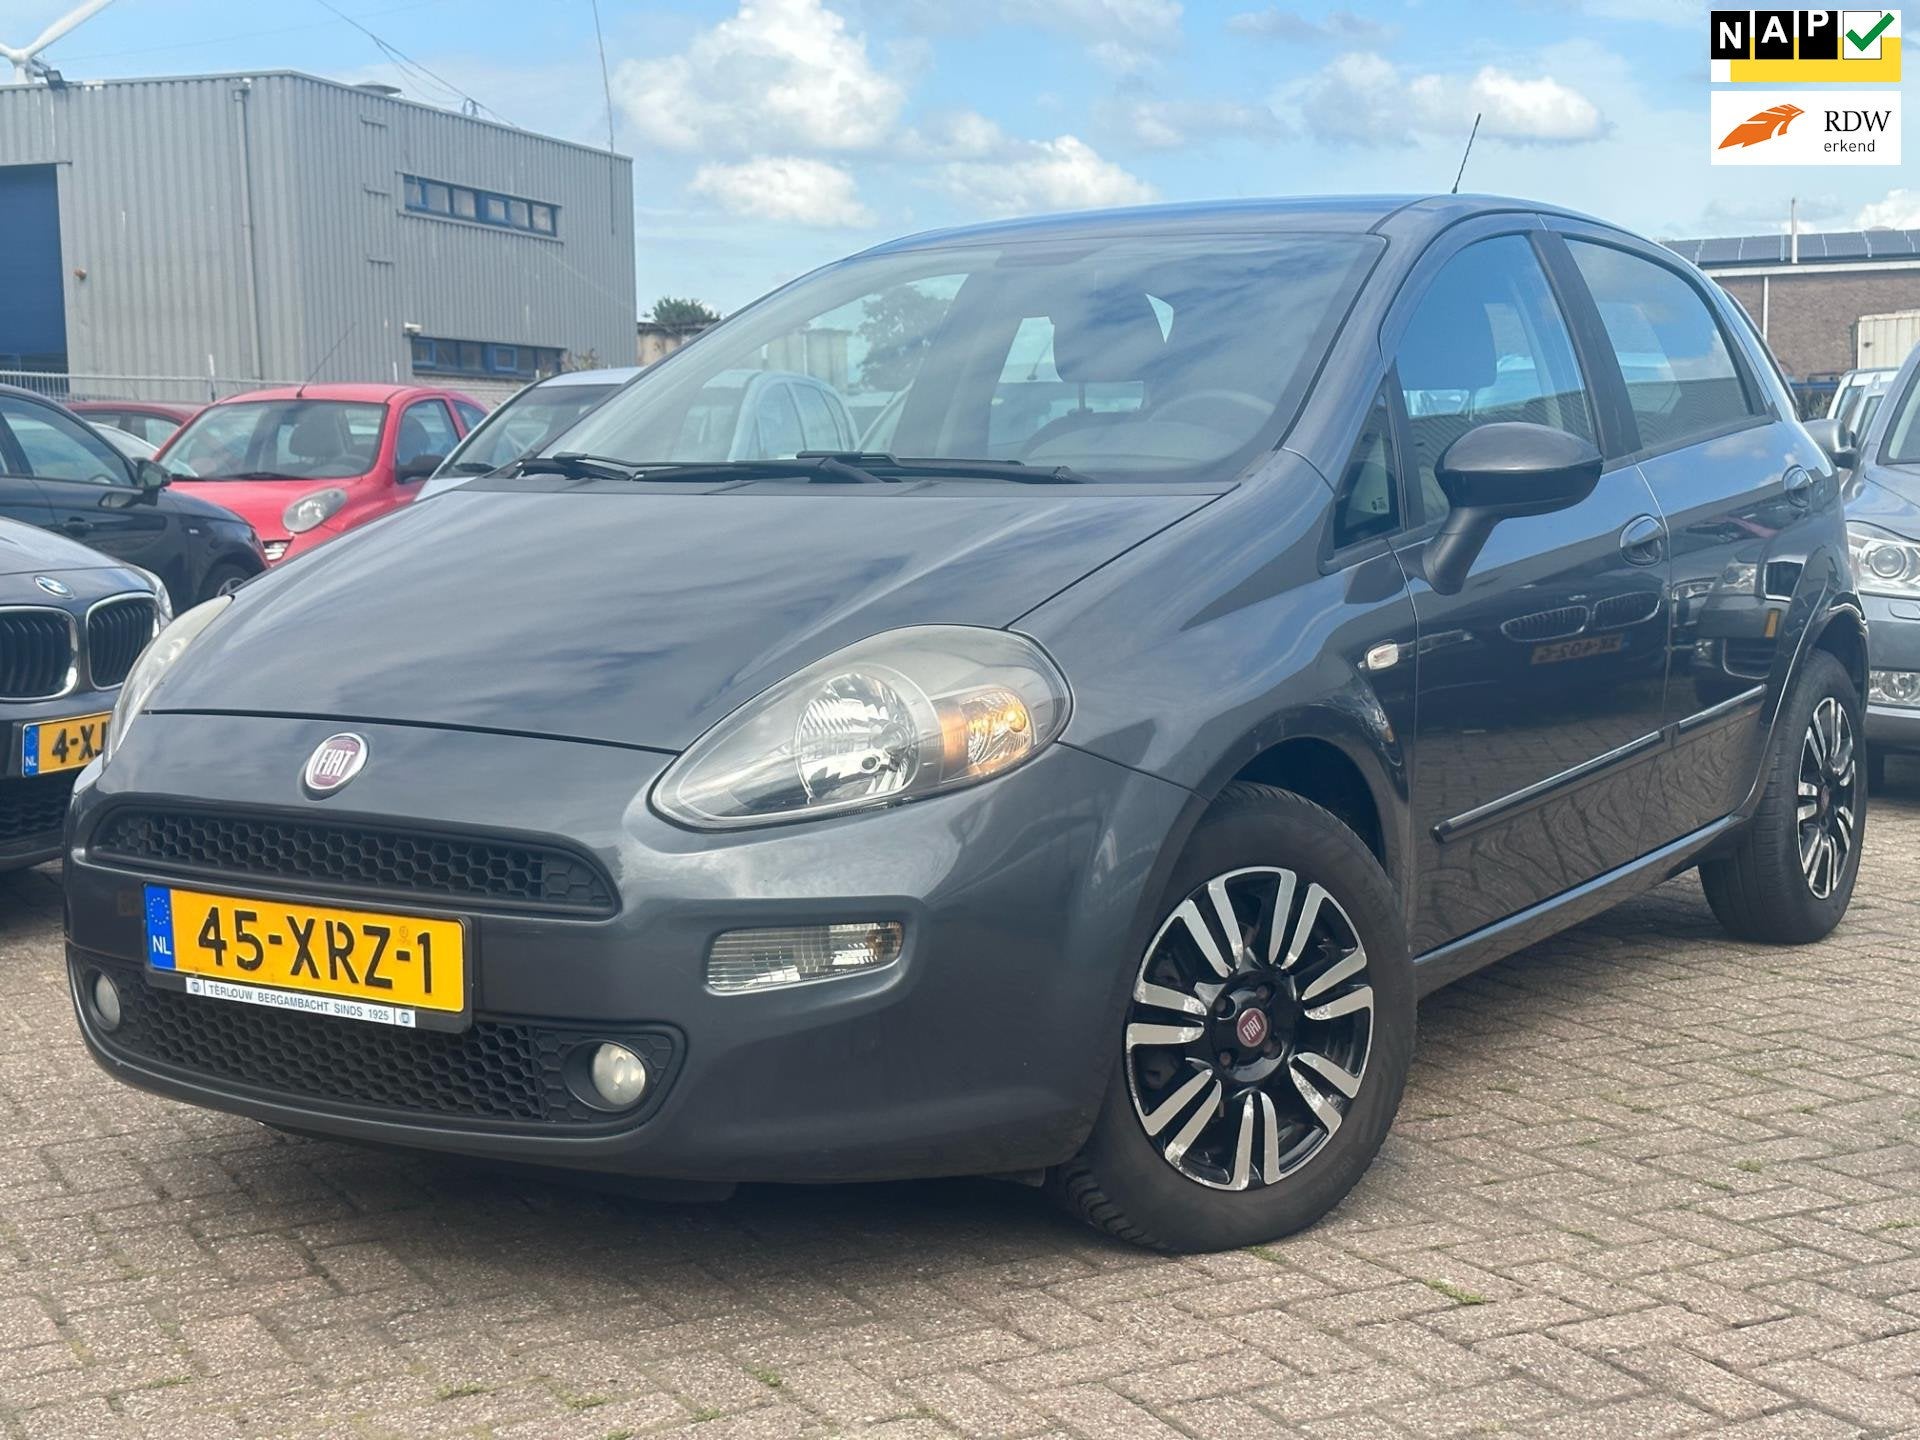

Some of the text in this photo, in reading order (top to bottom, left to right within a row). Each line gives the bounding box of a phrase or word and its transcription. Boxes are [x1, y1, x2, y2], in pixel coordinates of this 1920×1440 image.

[51, 721, 109, 763] 4-XJ
[315, 748, 356, 777] FIAT
[152, 935, 172, 956] NL
[198, 906, 432, 994] 45-XRZ-1
[258, 992, 329, 1012] BERGAMBACHT
[334, 1003, 363, 1017] SINDS
[368, 1008, 389, 1021] 1925
[1242, 1015, 1261, 1041] FIAT
